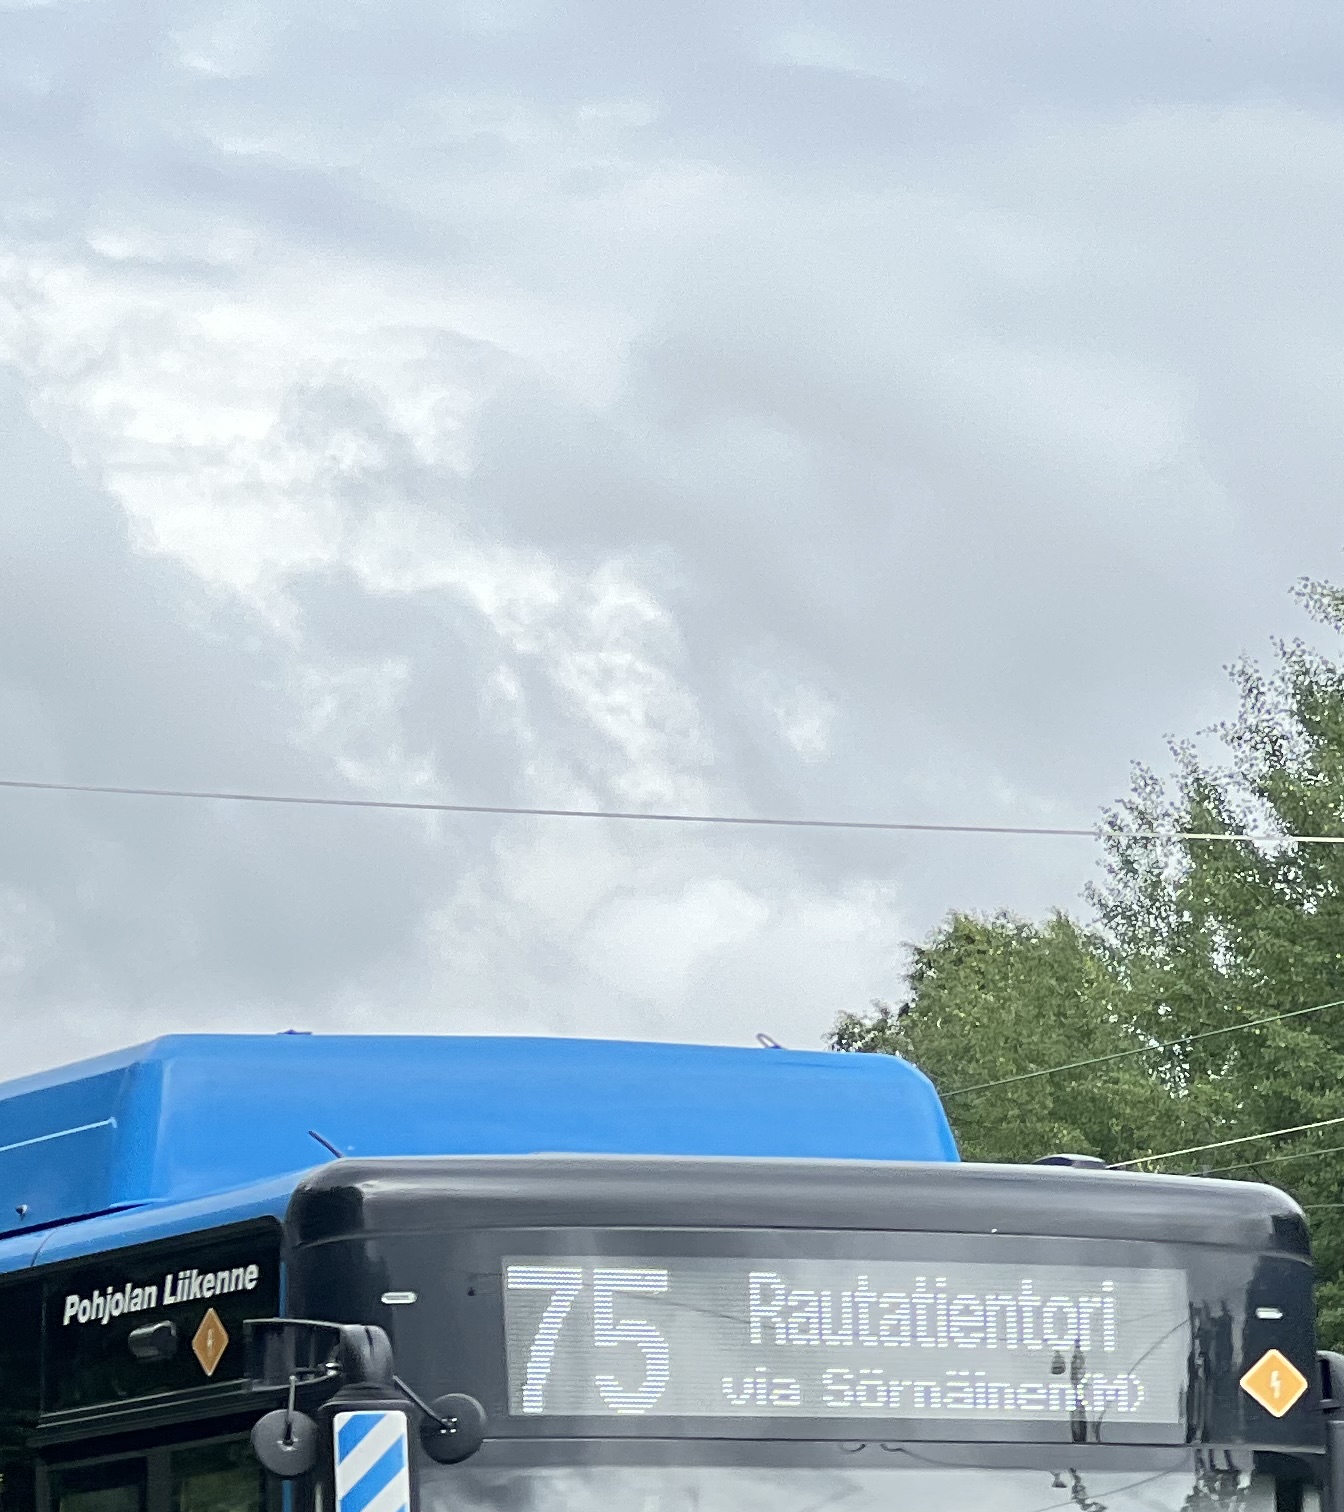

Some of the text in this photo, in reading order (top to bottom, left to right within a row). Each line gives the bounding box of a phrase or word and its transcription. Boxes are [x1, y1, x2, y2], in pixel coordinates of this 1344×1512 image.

[63, 1264, 259, 1325] Pohjolan Liikenne
[749, 1272, 1116, 1351] Rautatientori
[507, 1266, 669, 1414] 75
[722, 1367, 800, 1405] via
